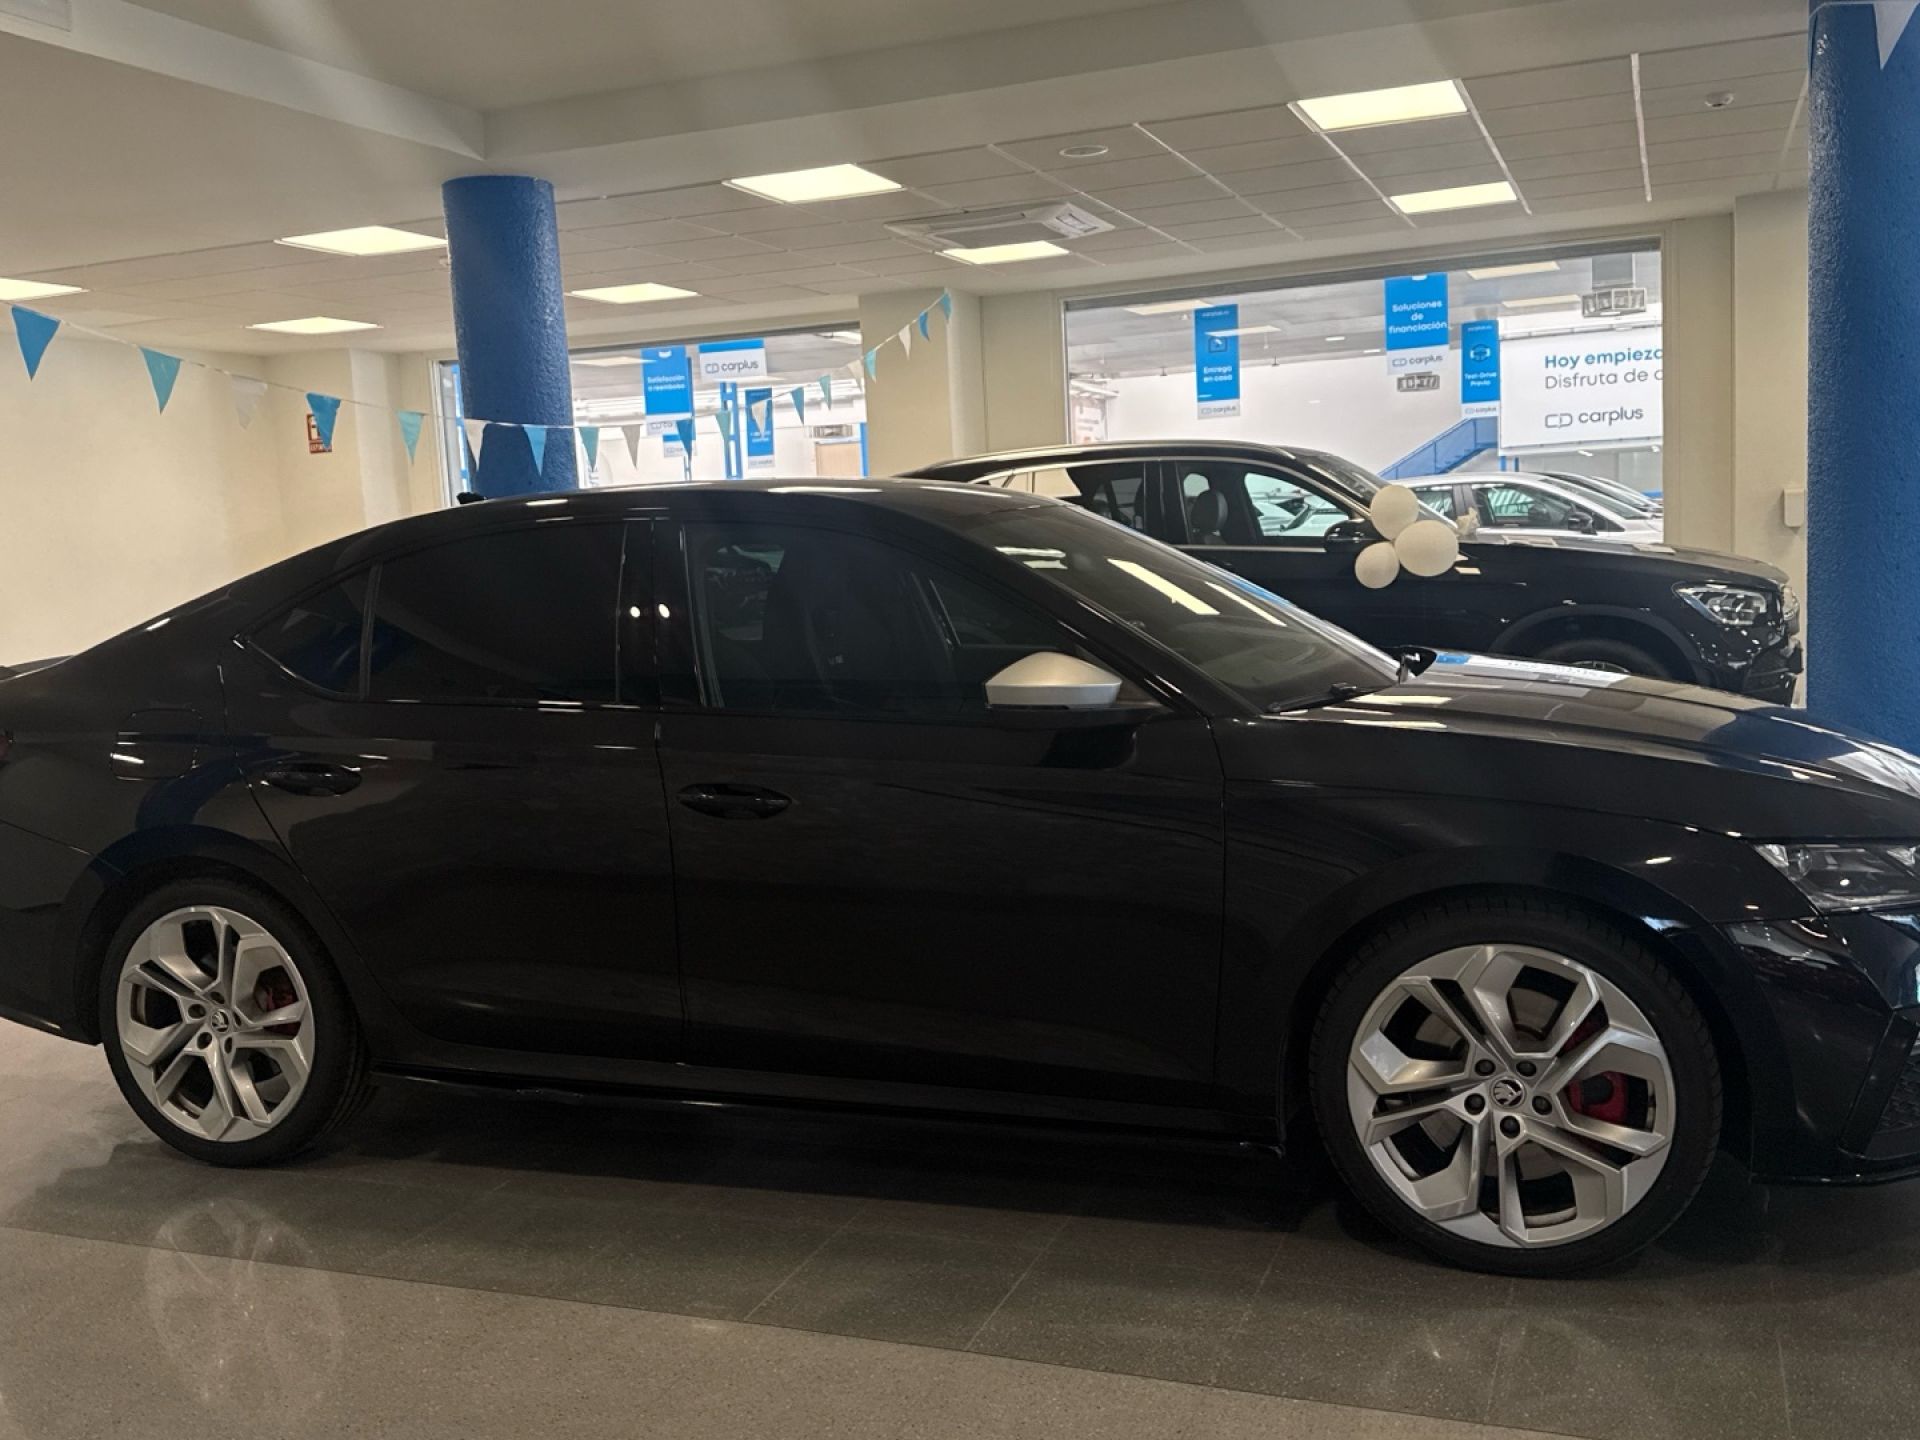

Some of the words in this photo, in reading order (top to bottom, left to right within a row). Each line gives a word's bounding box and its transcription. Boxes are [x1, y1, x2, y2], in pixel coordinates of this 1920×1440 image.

[1391, 300, 1443, 313] Soluciones
[1411, 312, 1424, 321] de
[1388, 321, 1448, 334] financiación
[721, 359, 759, 372] carplus
[1409, 355, 1443, 366] carplus
[1544, 354, 1580, 370] Hoy
[1203, 366, 1233, 374] Entrega
[1545, 371, 1618, 390] Disfruta
[1624, 368, 1648, 383] de
[1578, 406, 1644, 426] carplus
